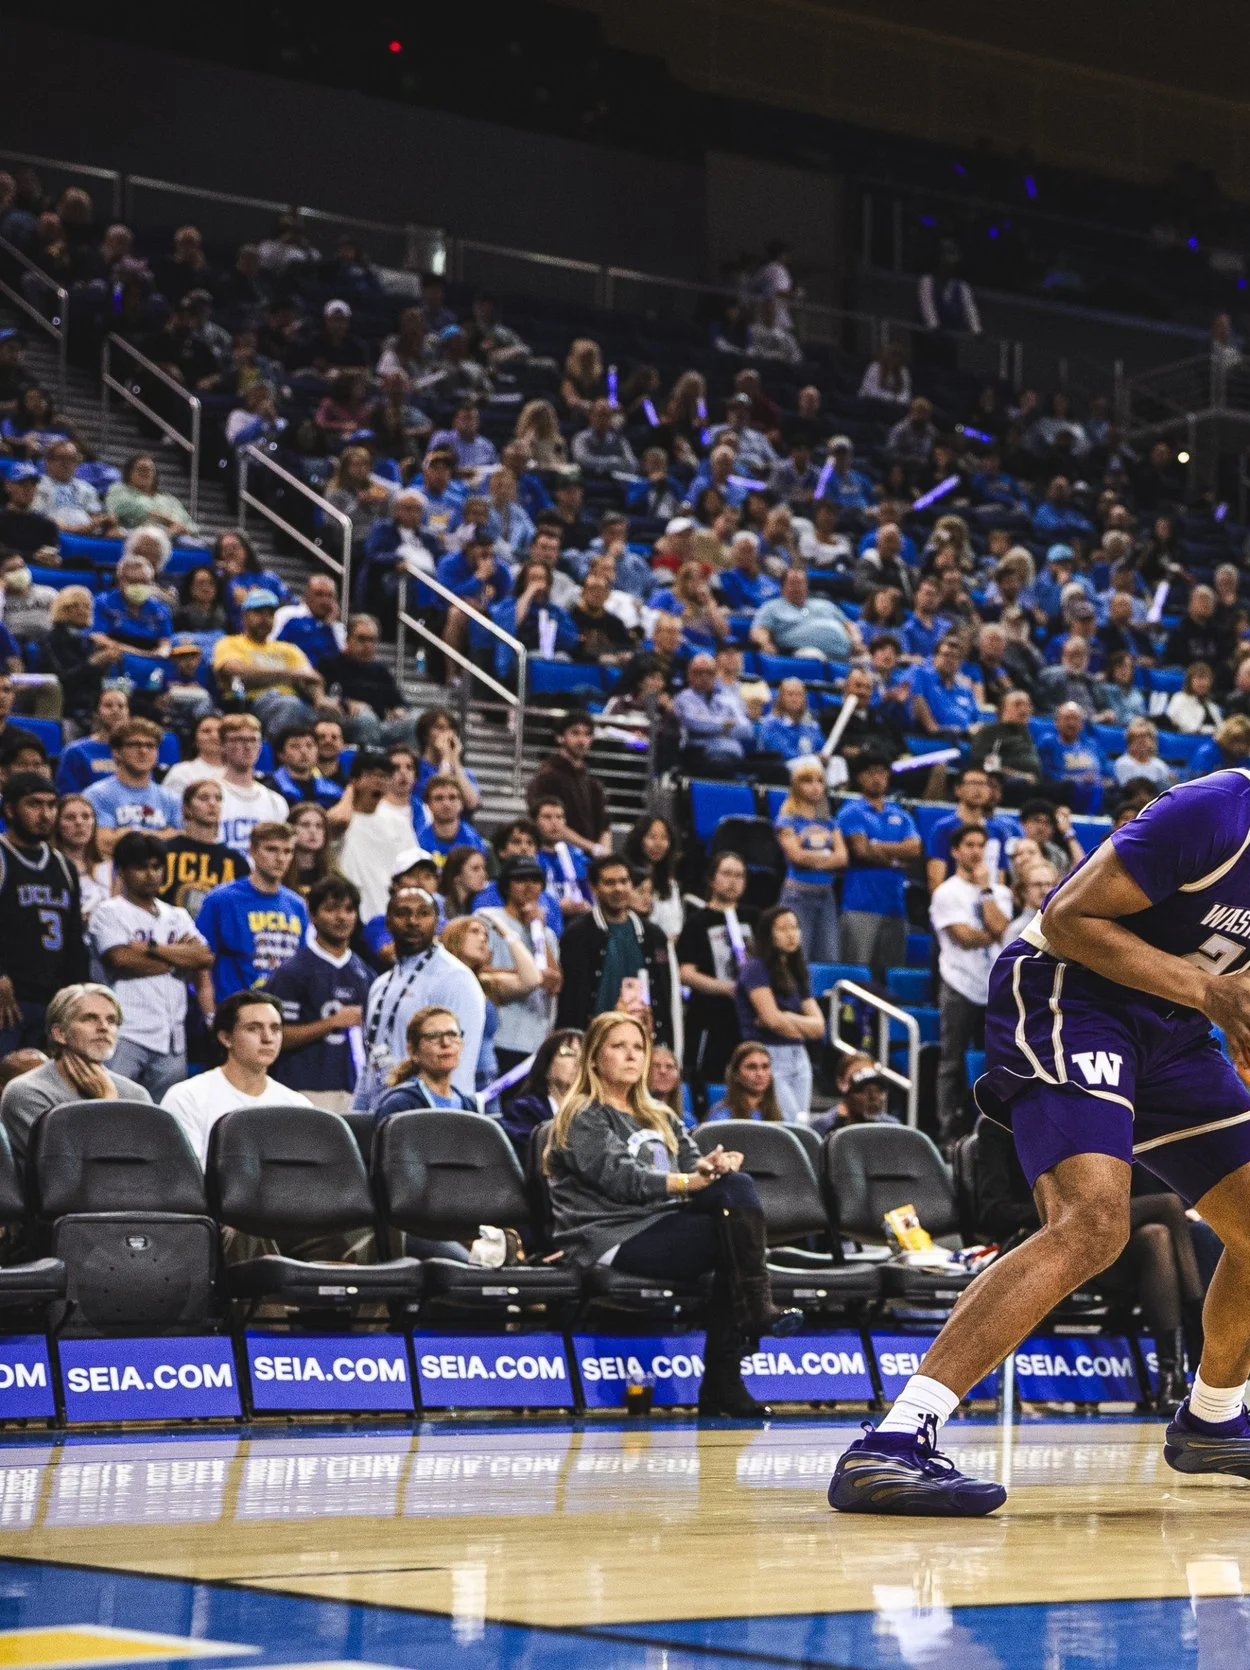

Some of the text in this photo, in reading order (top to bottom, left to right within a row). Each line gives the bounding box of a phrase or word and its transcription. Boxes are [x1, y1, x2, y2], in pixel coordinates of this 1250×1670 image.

[17, 883, 70, 911] UCLA
[39, 910, 63, 951] 3
[247, 911, 303, 937] UCLA
[1071, 1051, 1124, 1087] W
[254, 1356, 406, 1382] SEIA.COM
[421, 1354, 566, 1380] SEIA.COM
[740, 1352, 866, 1376] SEIA.COM
[1016, 1354, 1133, 1378] SEIA.COM
[68, 1363, 233, 1393] SEIA.COM
